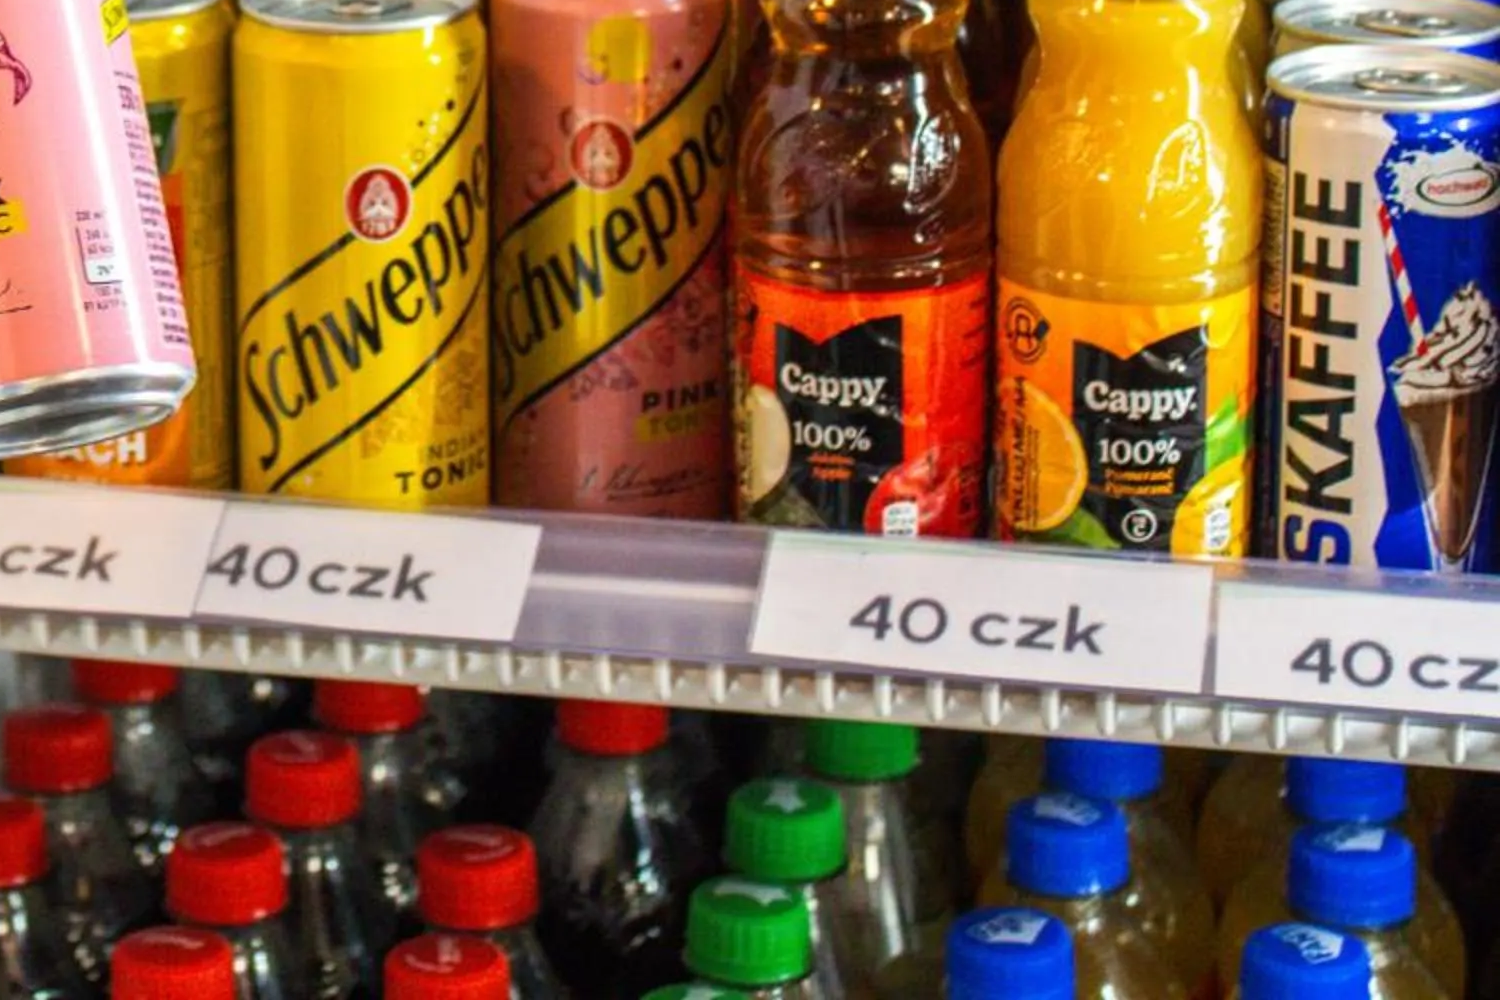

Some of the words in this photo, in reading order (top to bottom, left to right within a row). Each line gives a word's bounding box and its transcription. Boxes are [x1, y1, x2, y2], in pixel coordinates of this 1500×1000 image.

[642, 380, 721, 413] PINK
[793, 421, 872, 451] 100%
[1100, 437, 1182, 465] 100%
[206, 543, 301, 590] 40
[307, 553, 437, 603] czk
[849, 593, 950, 645] 40
[969, 604, 1108, 656] czk
[1290, 637, 1395, 688] 40
